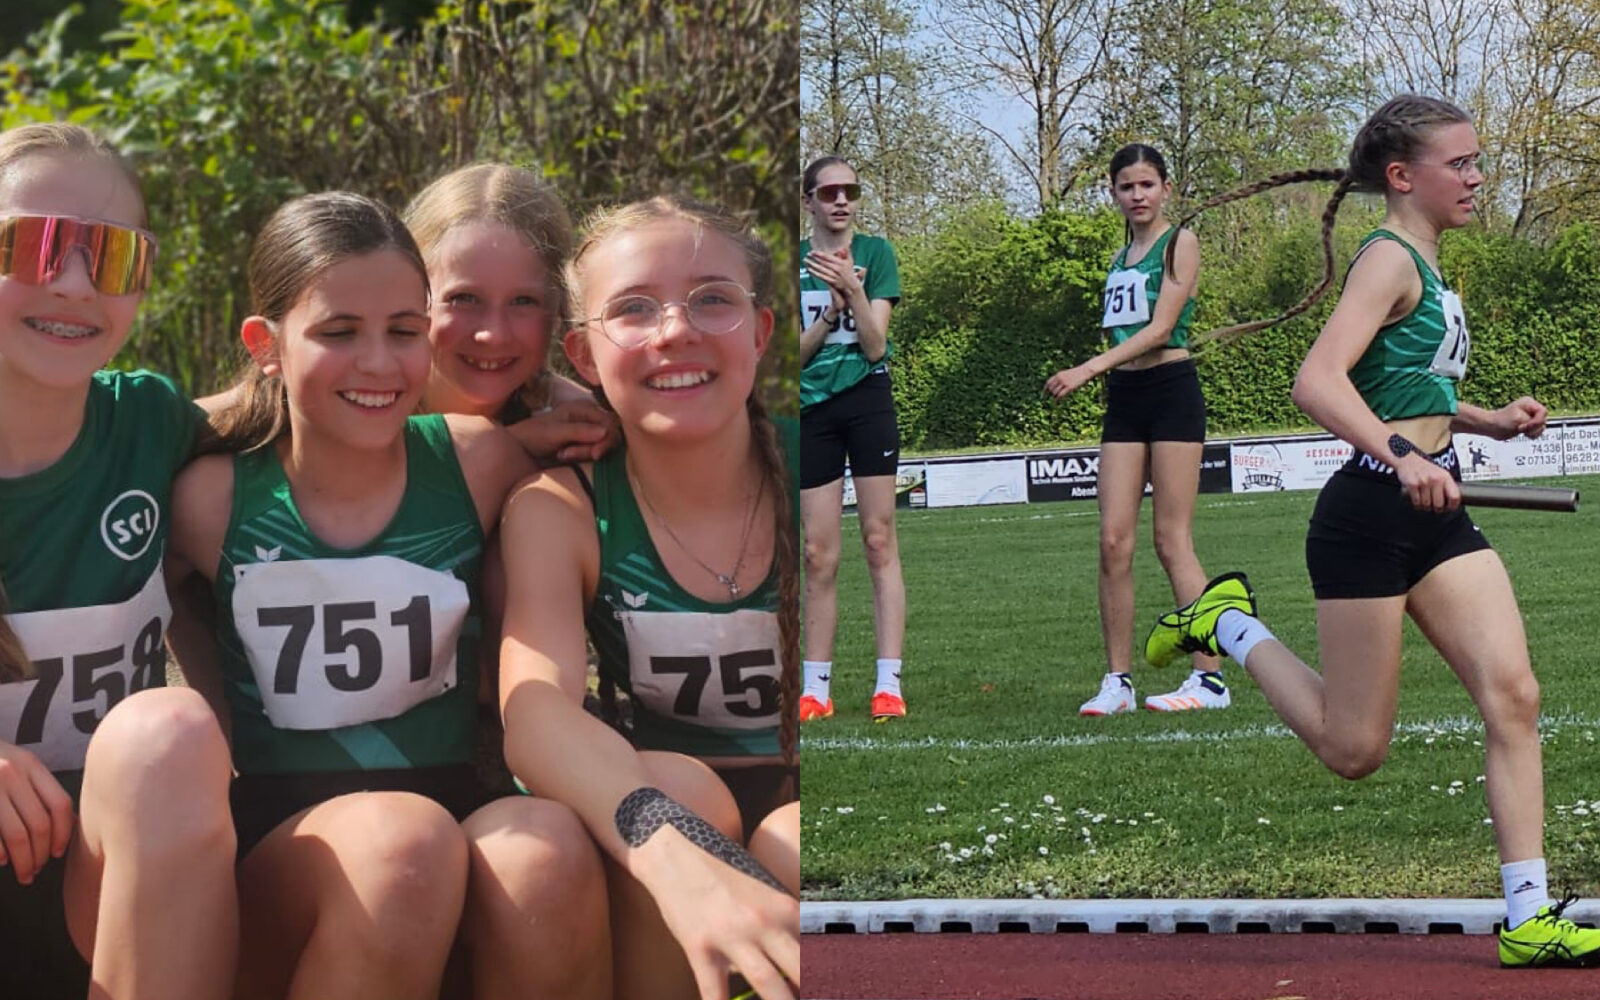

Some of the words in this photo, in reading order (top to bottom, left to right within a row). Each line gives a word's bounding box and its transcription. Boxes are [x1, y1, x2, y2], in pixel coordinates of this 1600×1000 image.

[1105, 283, 1136, 314] 751
[1532, 443, 1561, 454] 74336
[1030, 456, 1099, 478] IMAX
[111, 508, 151, 545] SCI
[256, 595, 432, 694] 751
[0, 616, 167, 746] 758
